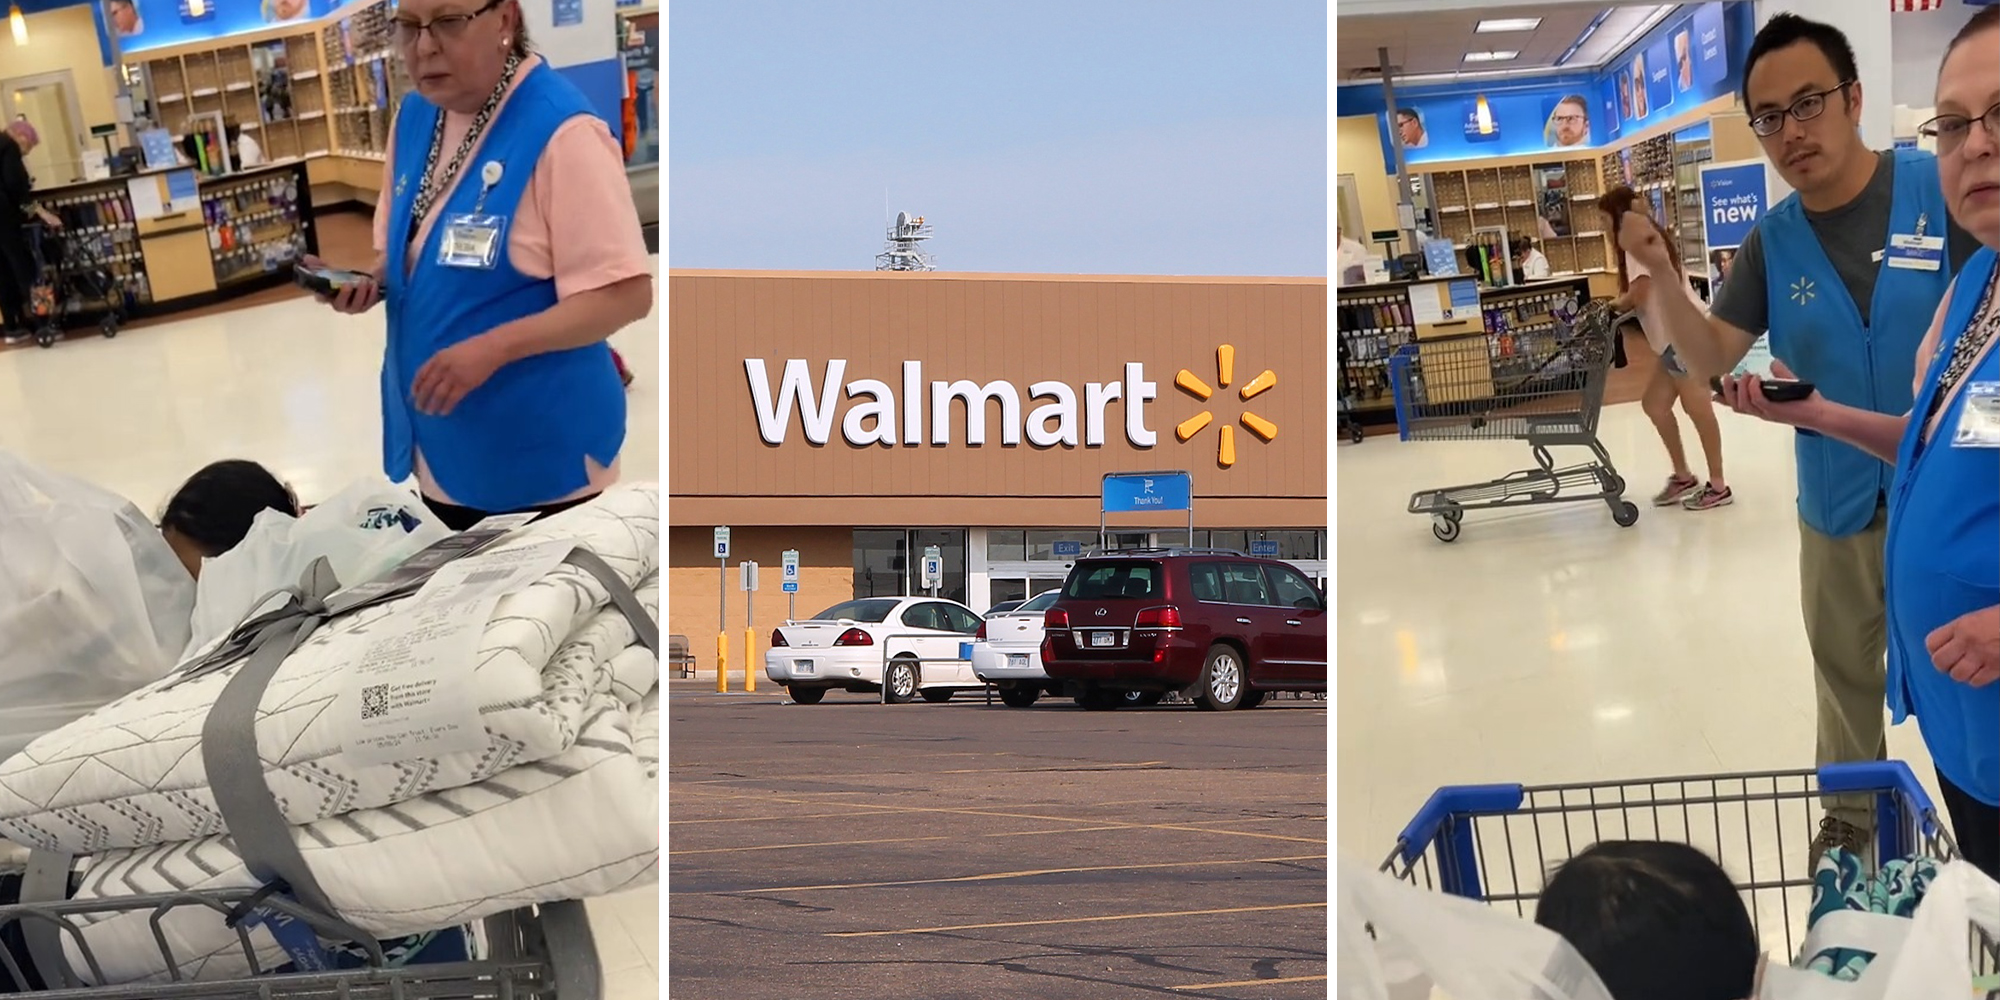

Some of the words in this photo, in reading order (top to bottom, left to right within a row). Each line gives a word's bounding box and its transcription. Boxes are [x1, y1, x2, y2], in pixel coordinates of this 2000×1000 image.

[1717, 179, 1733, 187] Vision
[1711, 196, 1728, 207] See
[1729, 192, 1758, 205] what's
[1712, 204, 1758, 224] new
[743, 358, 1158, 447] Walmart
[1134, 496, 1151, 505] Thank
[1152, 495, 1164, 505] You!
[1058, 543, 1075, 553] Exit
[1253, 543, 1276, 553] Enter
[390, 684, 401, 692] Get
[401, 682, 413, 690] free
[414, 679, 437, 688] delivery
[390, 693, 404, 701] from
[416, 688, 431, 696] store
[390, 701, 404, 709] with
